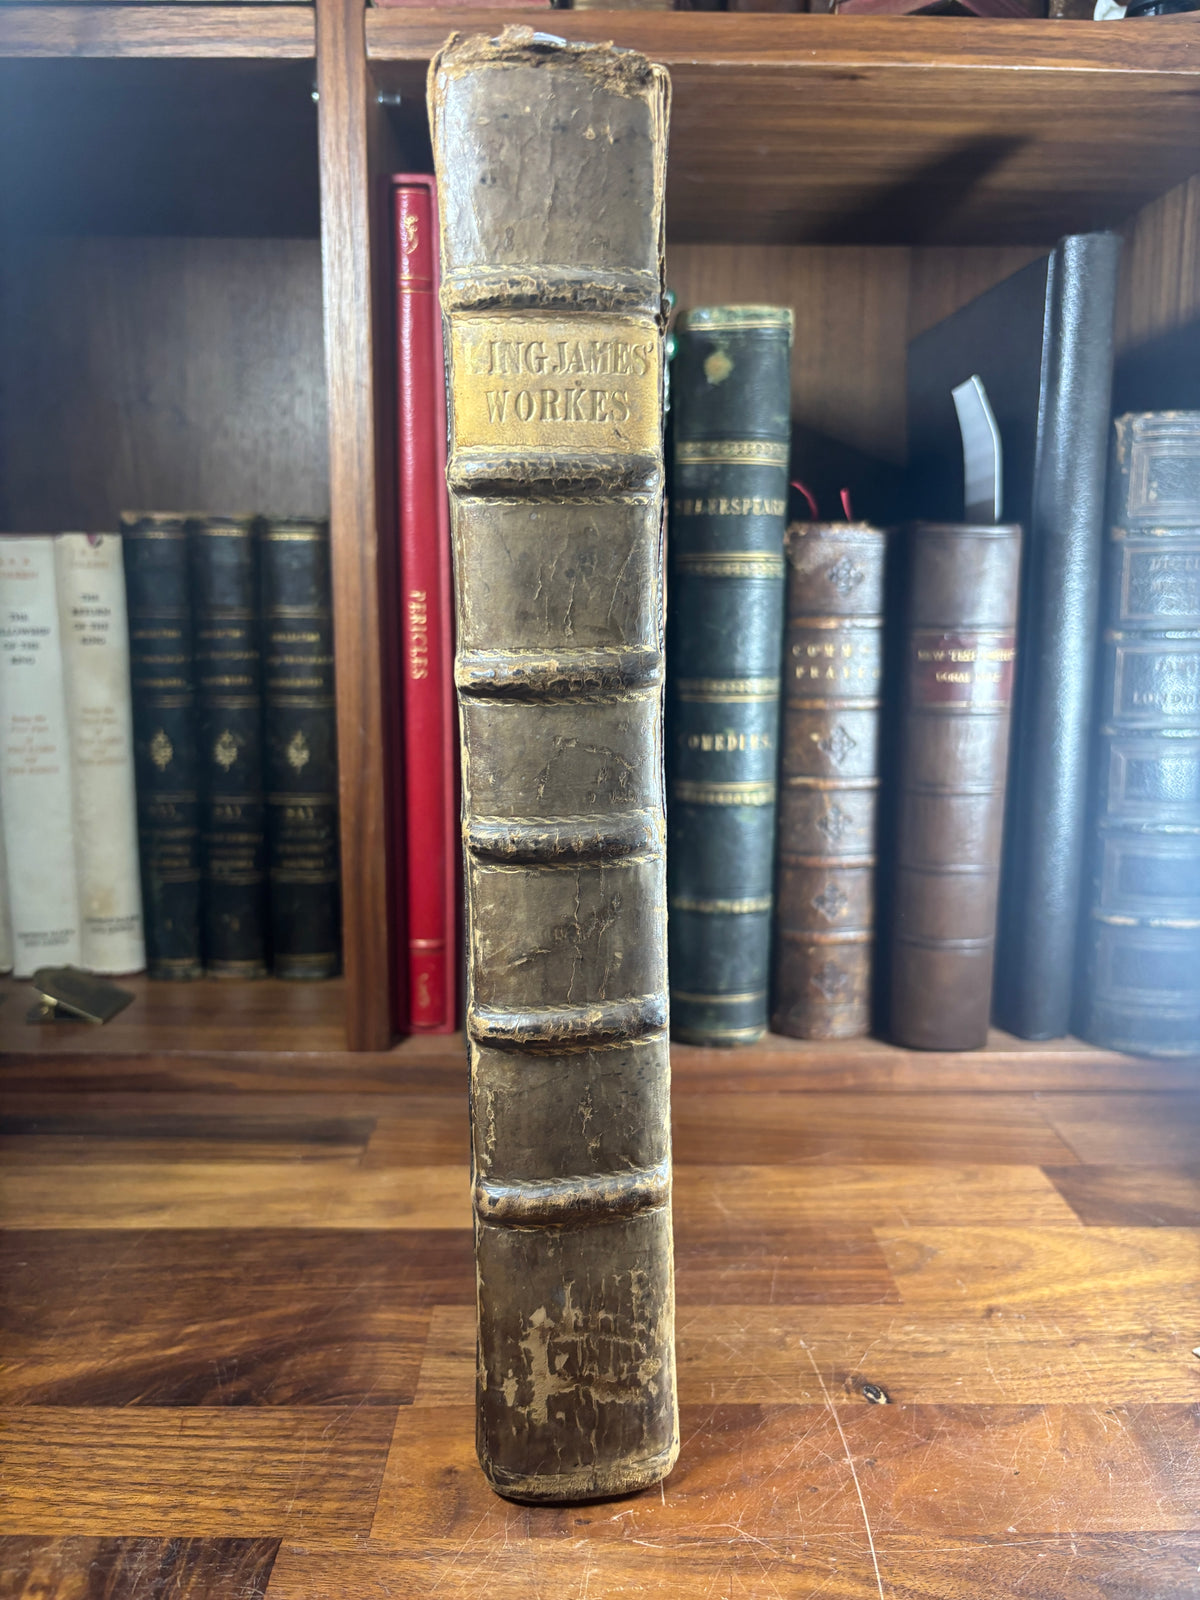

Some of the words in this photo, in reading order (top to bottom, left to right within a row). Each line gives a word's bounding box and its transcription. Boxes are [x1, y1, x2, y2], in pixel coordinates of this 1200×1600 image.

[485, 388, 631, 424] WORKES
[408, 590, 429, 680] PERICLES
[679, 733, 771, 751] OMEDIES
